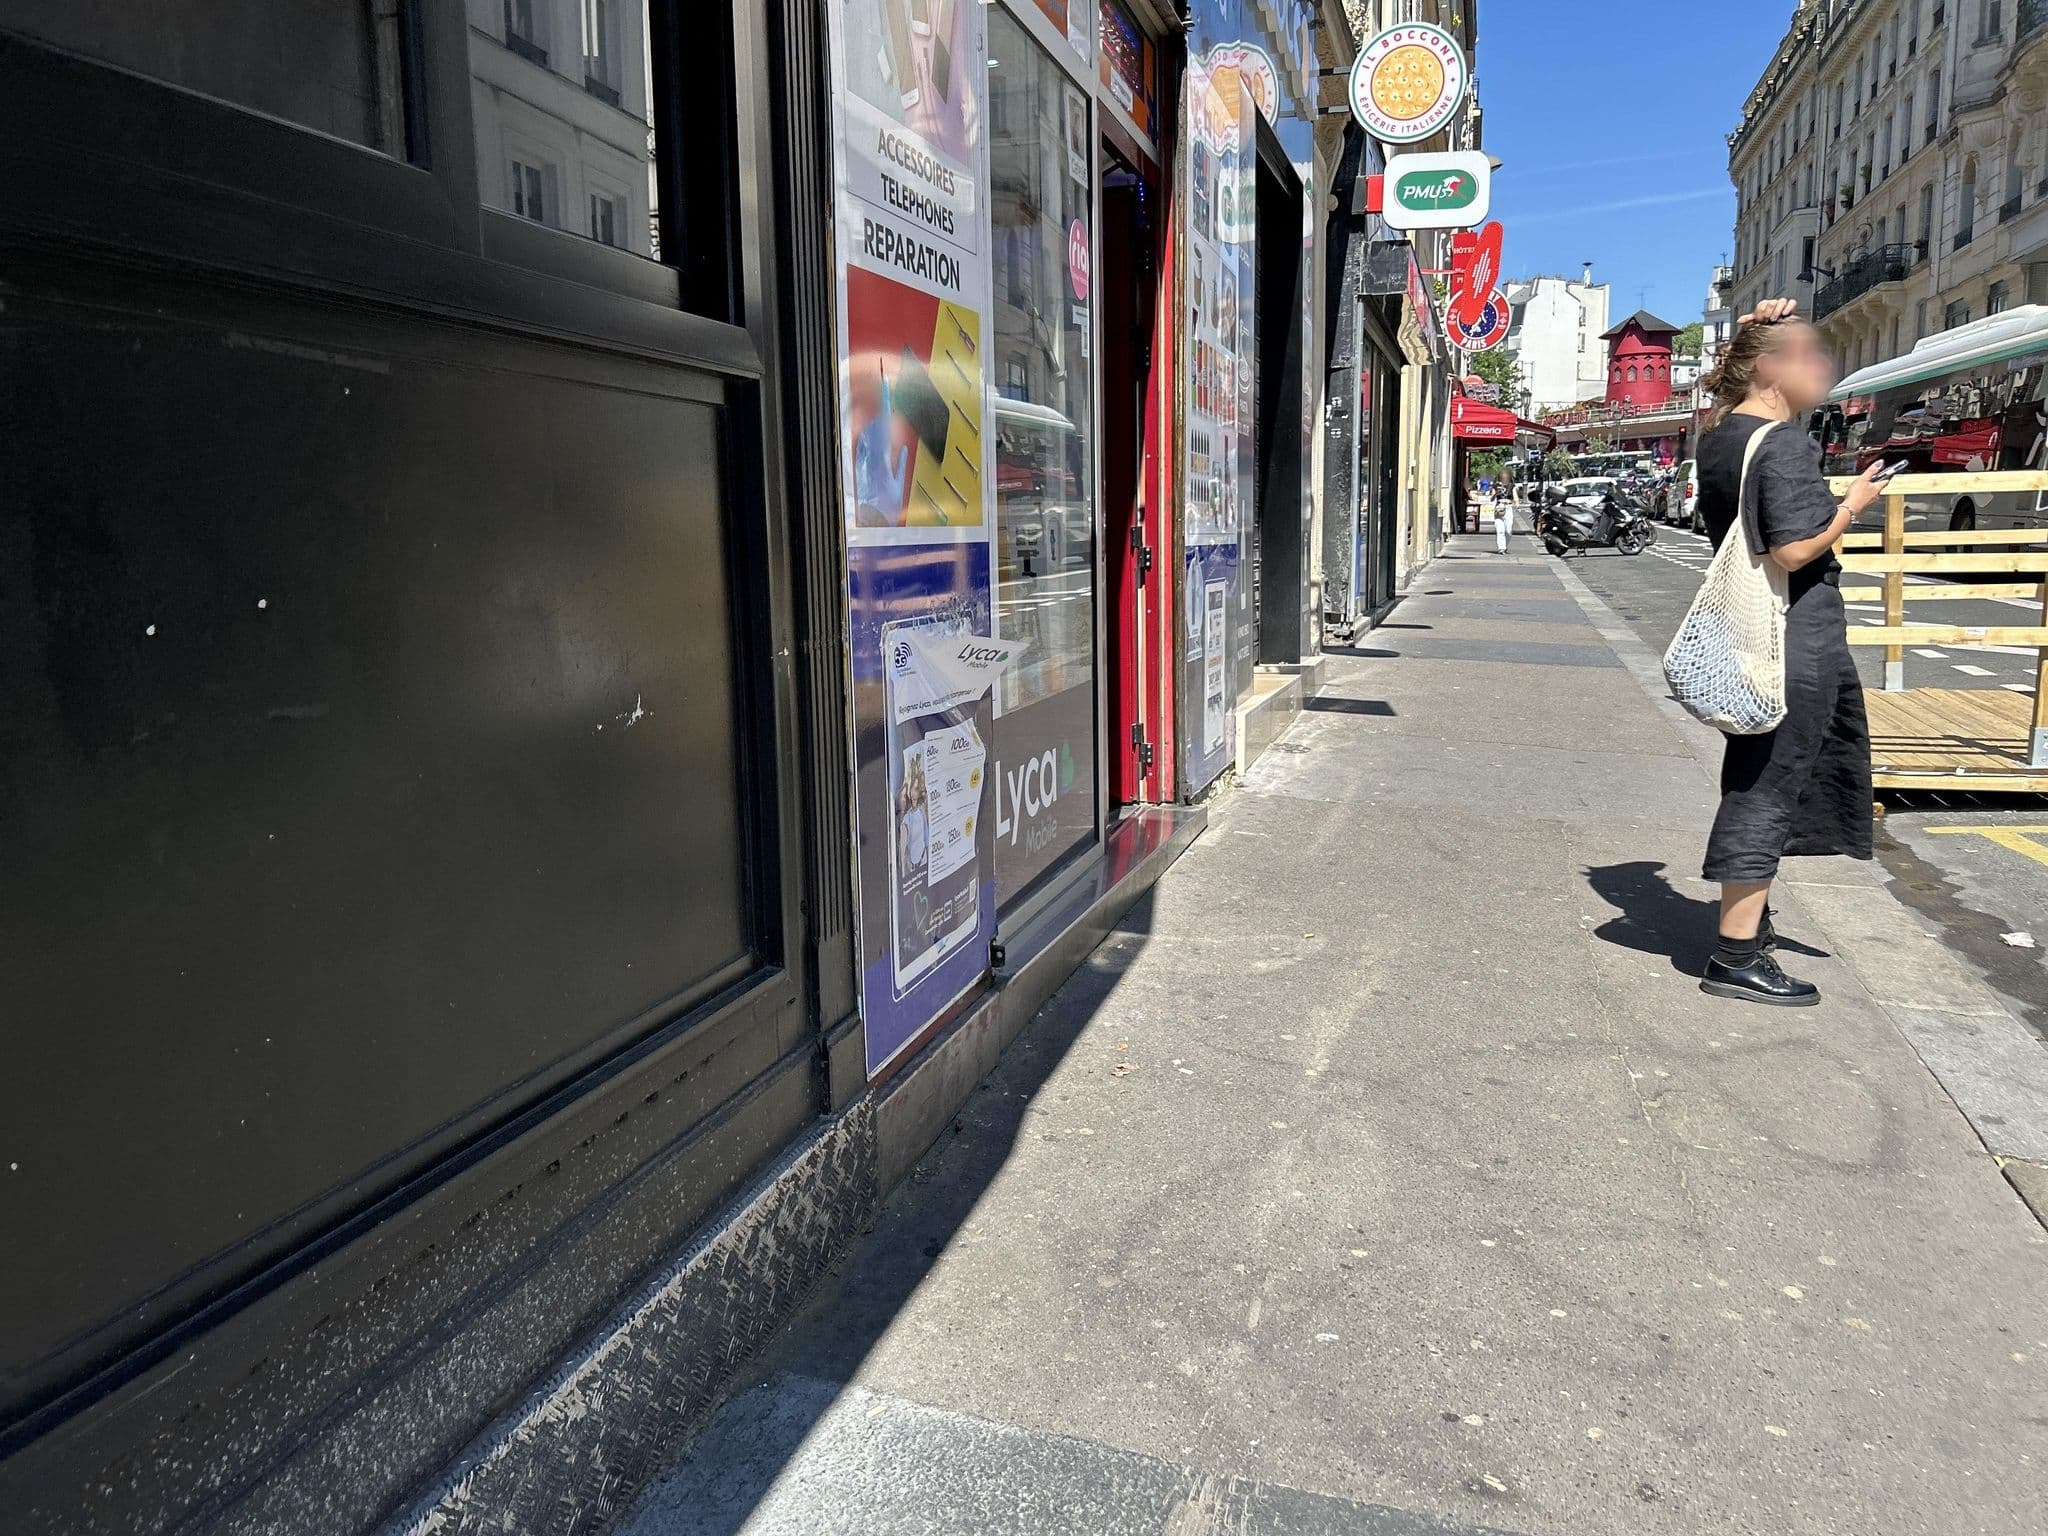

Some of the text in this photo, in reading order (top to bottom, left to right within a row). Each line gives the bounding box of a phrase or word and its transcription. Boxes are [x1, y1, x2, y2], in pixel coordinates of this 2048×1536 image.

[1362, 30, 1456, 69] IL BOCCONE
[1401, 96, 1452, 132] ITALIENNE
[878, 128, 955, 196] ACCESSOIRES
[880, 173, 954, 235] TELEPHONES
[1403, 185, 1442, 199] PMU
[864, 218, 961, 291] REPARATION
[1460, 337, 1488, 350] PARIS
[1465, 425, 1502, 435] Pizzeria
[957, 643, 1001, 662] Lyca
[995, 747, 1057, 847] Lyca
[1025, 816, 1057, 858] Mobile
